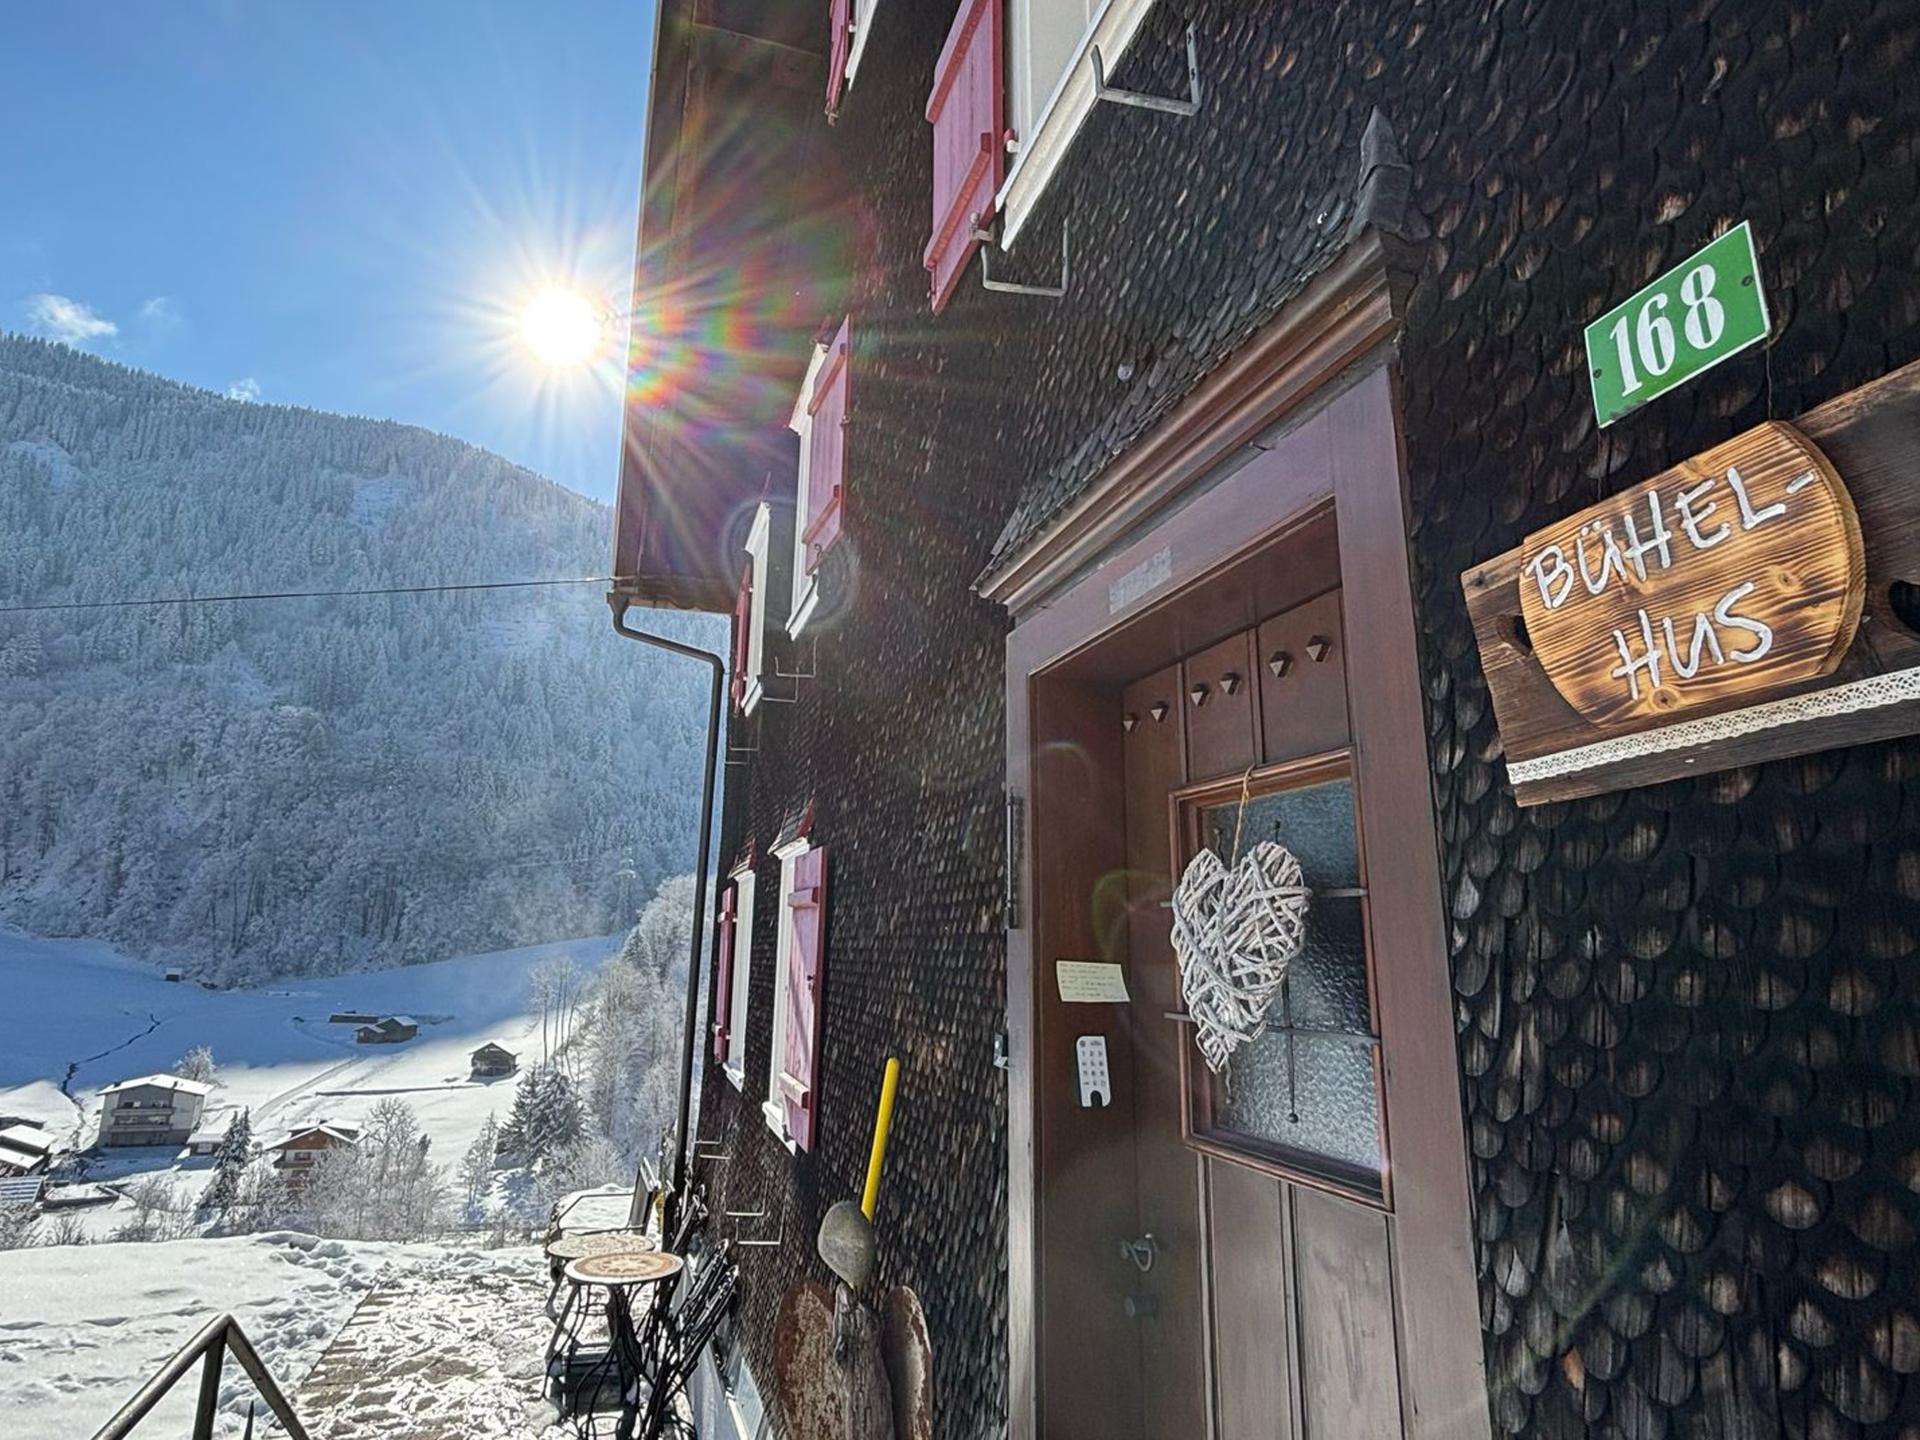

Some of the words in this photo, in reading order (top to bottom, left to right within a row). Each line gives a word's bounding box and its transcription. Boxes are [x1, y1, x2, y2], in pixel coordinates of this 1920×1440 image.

[1609, 264, 1725, 397] 168
[1525, 467, 1815, 609] BÜHEL-
[1612, 582, 1772, 699] HUS
